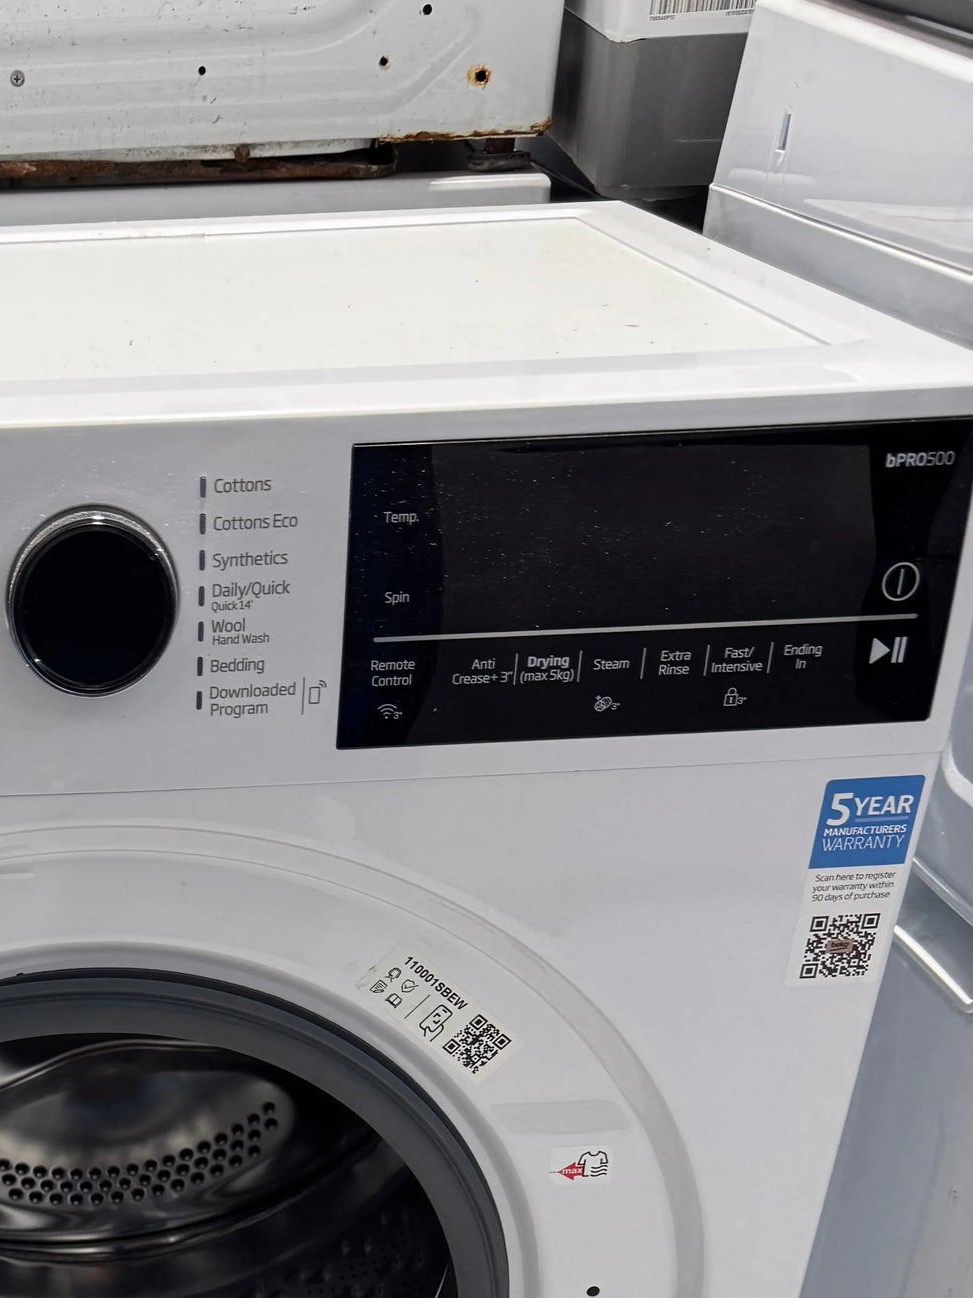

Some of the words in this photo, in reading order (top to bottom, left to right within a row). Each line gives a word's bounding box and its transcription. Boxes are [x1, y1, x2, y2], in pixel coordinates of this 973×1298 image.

[886, 451, 955, 468] bPRO500
[214, 479, 272, 493] Cottons
[213, 516, 270, 531] Cottons
[273, 514, 298, 528] Eco
[384, 511, 419, 525] Temp.
[212, 551, 288, 570] Synthetics
[212, 580, 290, 600] Daily/Quick
[384, 591, 410, 605] Spin
[211, 601, 238, 613] Quick
[211, 618, 246, 633] Wool
[212, 634, 240, 646] Hand
[242, 632, 270, 644] Wash
[661, 650, 691, 662] Extra
[725, 647, 754, 659] Fast/
[784, 644, 822, 657] Ending
[210, 658, 265, 675] Bedding
[371, 660, 415, 671] Remote
[471, 658, 496, 670] Anti
[527, 656, 570, 670] Drying
[593, 658, 630, 671] Steam
[659, 664, 689, 675] Rinse
[711, 660, 762, 673] Intensive
[795, 658, 806, 669] In
[372, 674, 412, 687] Control
[452, 673, 499, 685] Crease+
[520, 670, 548, 684] (max
[549, 669, 574, 683] 5kg)
[210, 682, 296, 699] Downloaded
[210, 702, 268, 718] Program
[826, 792, 854, 826] 5
[854, 794, 914, 816] YEAR
[823, 824, 907, 837] MANUFACTURERS
[822, 834, 905, 852] WARRANTY
[815, 874, 834, 882] Scan
[866, 872, 896, 881] register
[812, 885, 831, 893] your
[832, 883, 868, 891] warranty
[869, 881, 894, 889] within
[812, 894, 823, 902] 90
[825, 893, 842, 902] days
[844, 892, 853, 900] of
[854, 891, 890, 901] purchase
[404, 956, 468, 1010] 110001SBEW
[562, 1167, 583, 1175] max
